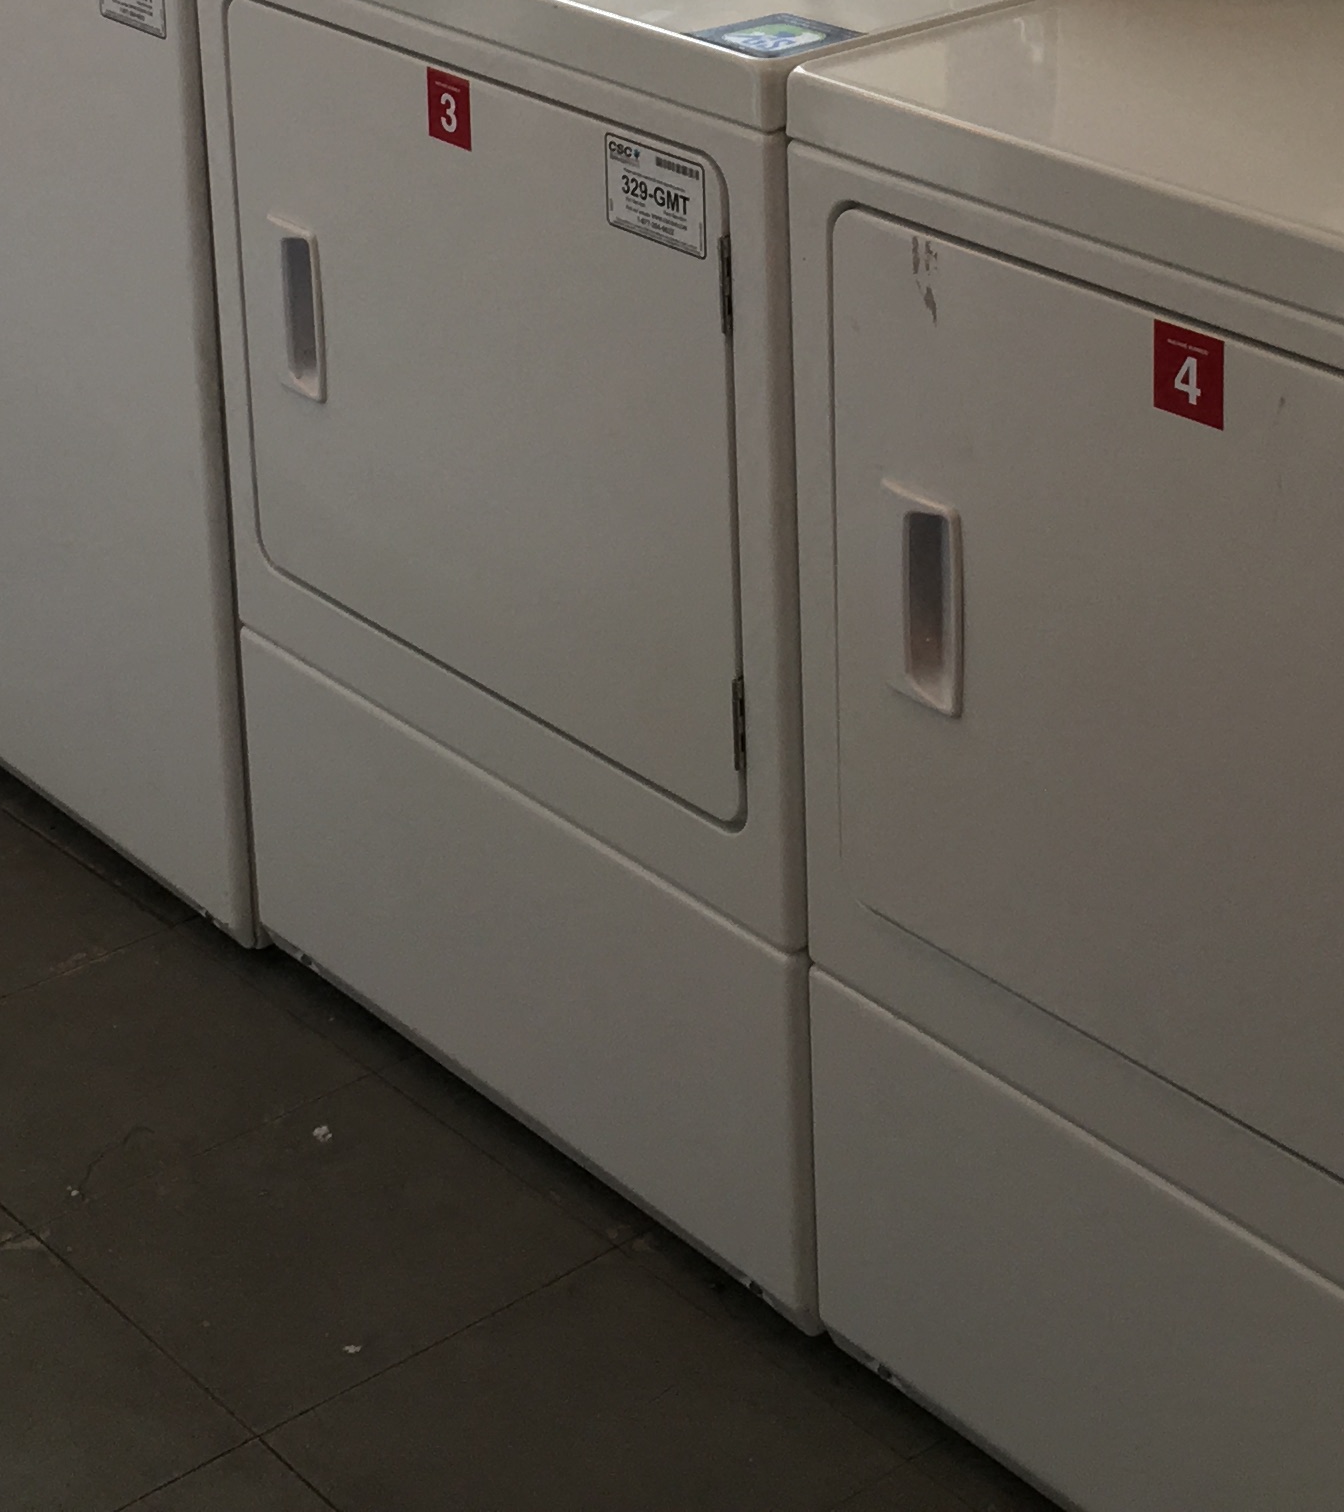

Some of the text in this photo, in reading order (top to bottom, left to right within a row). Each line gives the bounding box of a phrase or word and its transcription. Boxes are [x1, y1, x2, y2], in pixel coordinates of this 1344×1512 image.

[440, 92, 457, 133] 3
[608, 141, 632, 158] CSC
[621, 174, 690, 215] 329-GMT
[1173, 356, 1202, 406] 4
